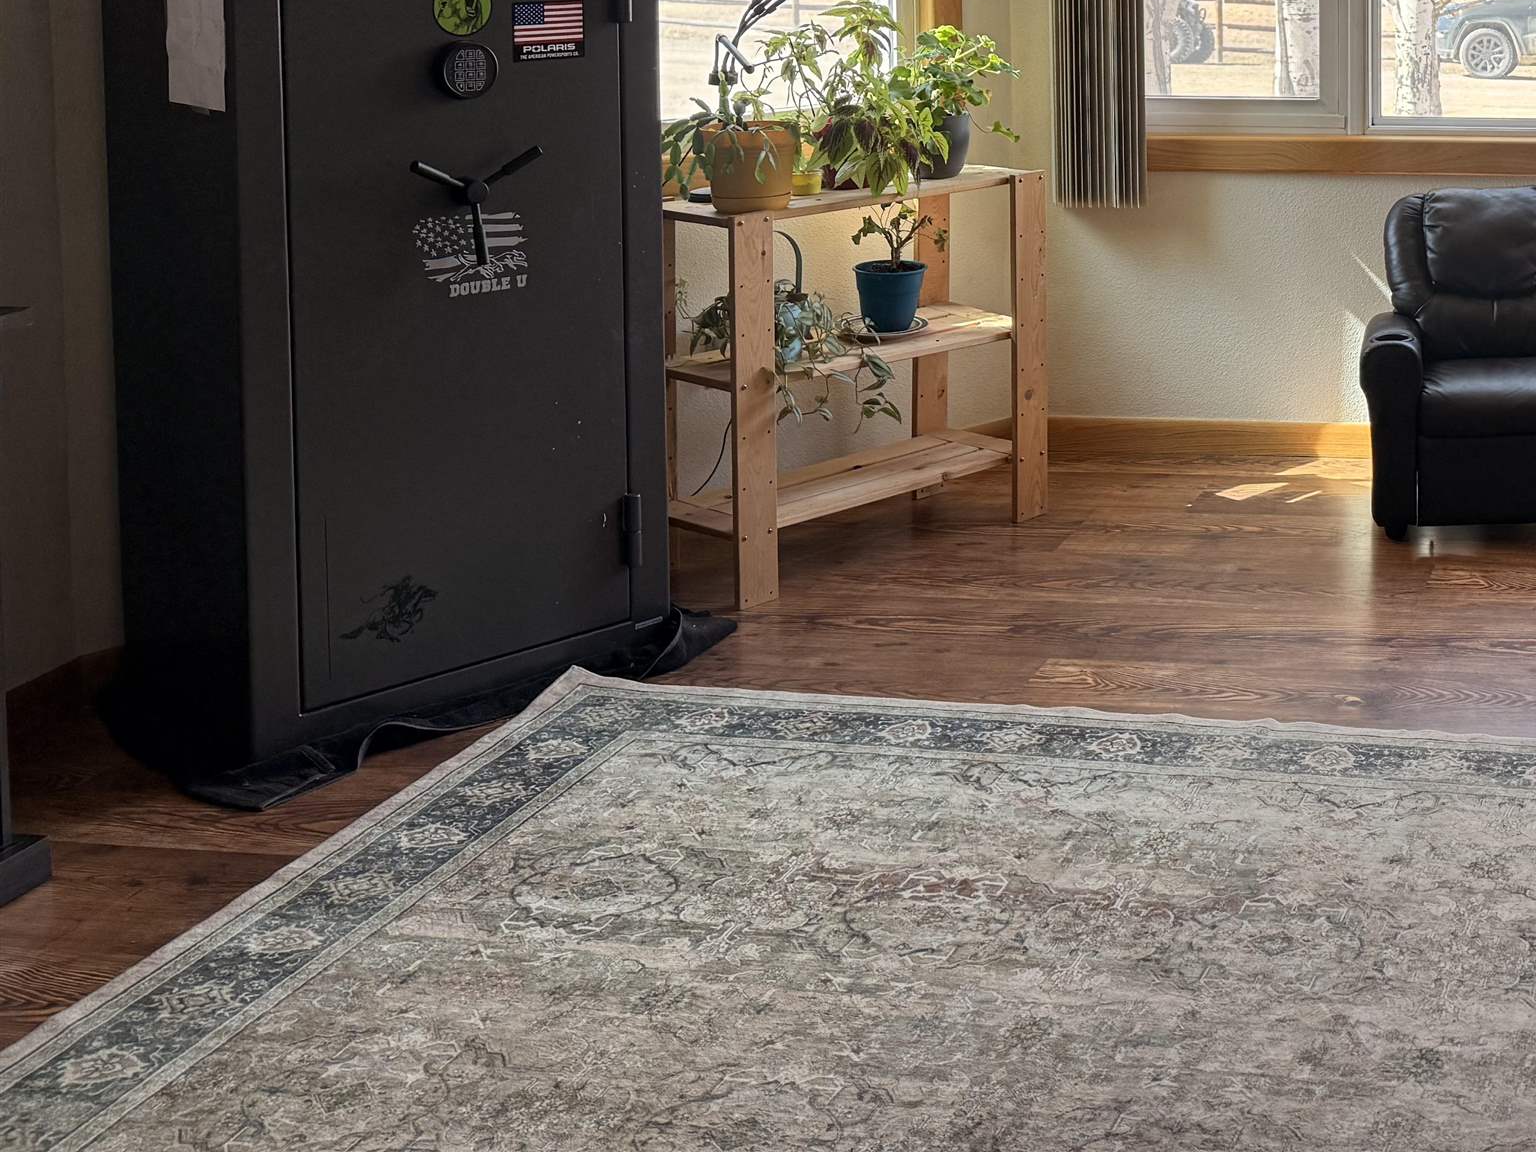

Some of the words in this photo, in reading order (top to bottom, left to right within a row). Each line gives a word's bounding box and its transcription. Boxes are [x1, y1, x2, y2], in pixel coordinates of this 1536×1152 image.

[522, 43, 576, 53] POLARIS
[449, 276, 511, 298] DOUBLE
[516, 274, 528, 288] U
